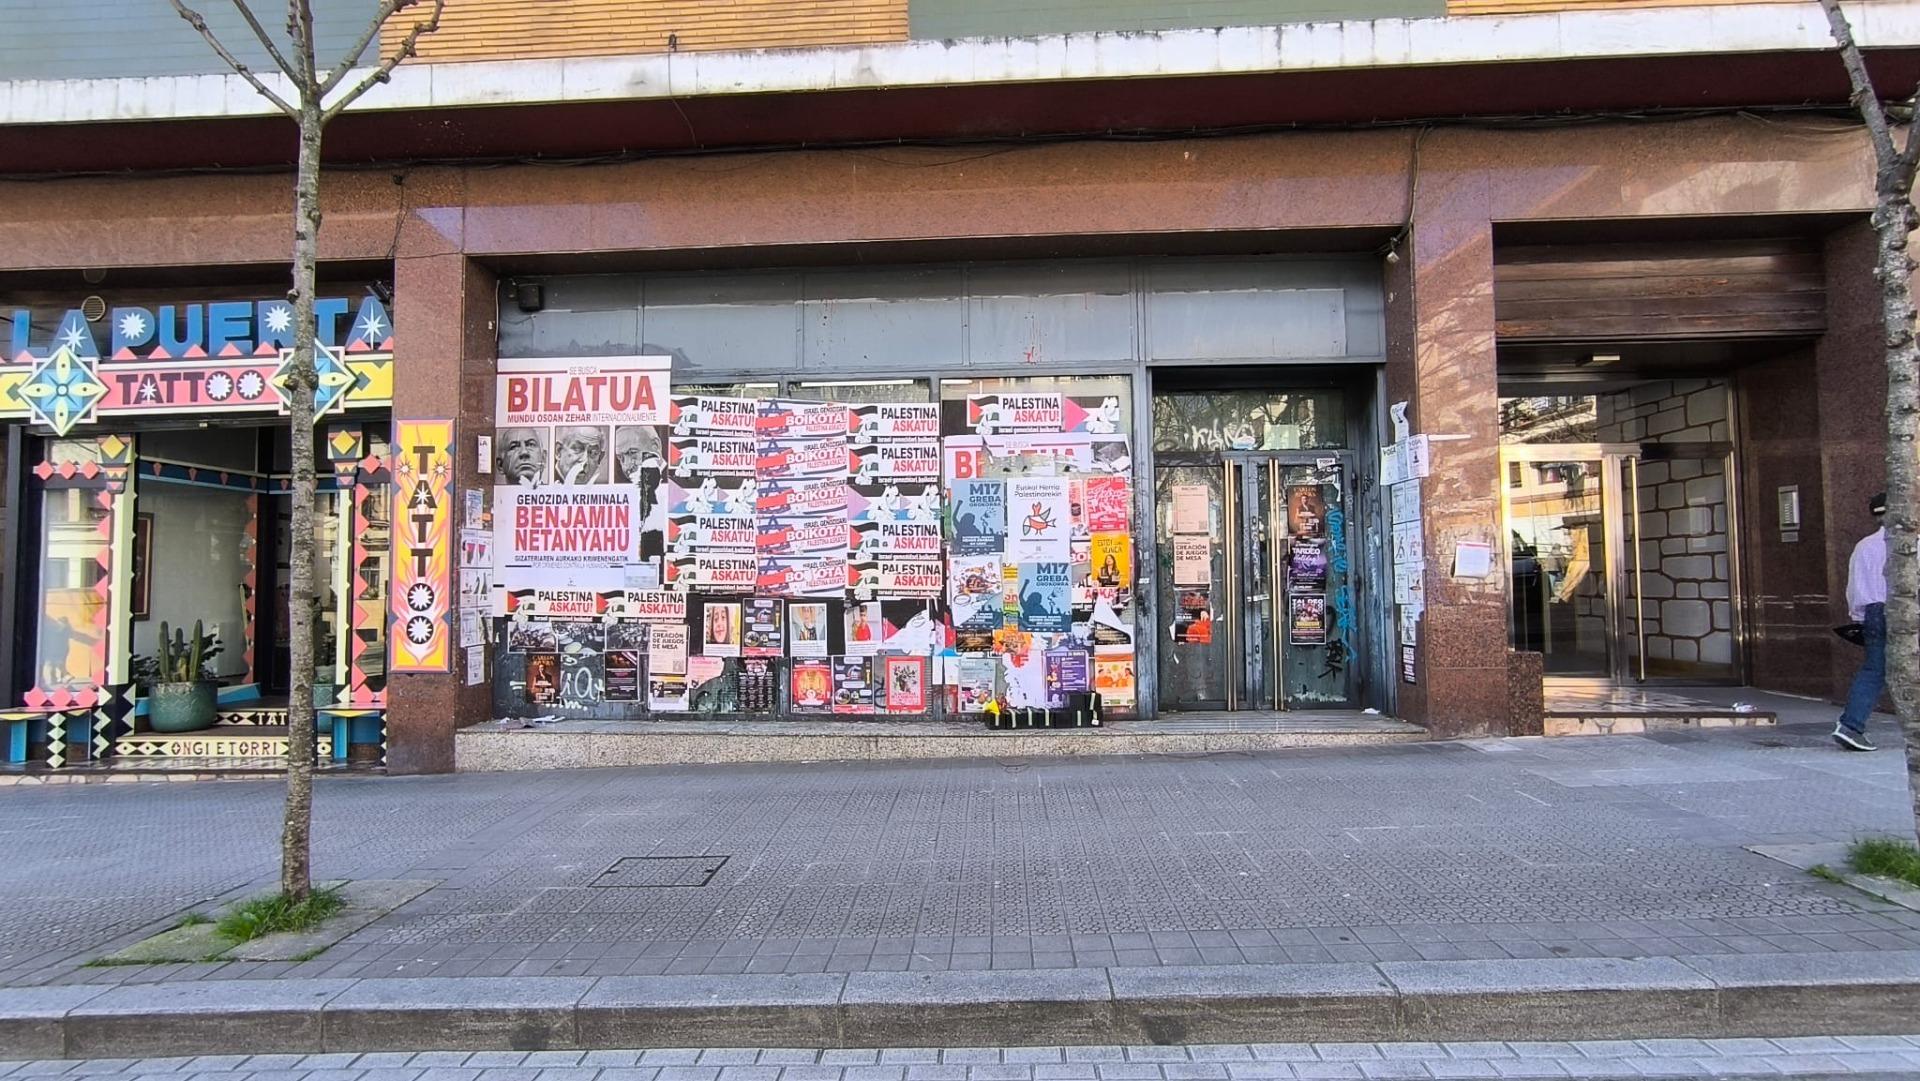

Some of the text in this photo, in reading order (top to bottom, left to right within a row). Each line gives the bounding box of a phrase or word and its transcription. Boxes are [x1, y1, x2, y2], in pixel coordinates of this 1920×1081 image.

[12, 296, 393, 360] LA PUERTA
[115, 370, 266, 406] TATTOO
[507, 376, 656, 413] BILATUA
[701, 400, 755, 414] PALESTINA
[1002, 397, 1060, 410] PALESTINA
[507, 414, 535, 423] MUNDU
[537, 414, 564, 423] OSOAN
[565, 413, 592, 422] ZEHAR
[785, 412, 847, 426] BOIKOTA!
[881, 407, 938, 420] PALESTINA
[1013, 410, 1060, 422] ASKATU!
[711, 414, 755, 427] ASKATU!
[892, 420, 937, 432] ASKATU!
[701, 441, 756, 454] PALESTINA
[881, 447, 938, 459] PALESTINA
[711, 454, 756, 466] ASKATU!
[785, 445, 847, 464] BOIKOTA!
[893, 459, 938, 472] ASKATU!
[786, 486, 848, 504] BOIKOTA!
[969, 483, 1001, 496] M17
[517, 494, 629, 505] GENOZIDA KRIMINALA
[515, 506, 630, 528] BENJAMIN
[700, 518, 755, 530] PALESTINA
[882, 524, 938, 537] PALESTINA
[711, 531, 755, 543] ASKATU!
[786, 525, 847, 542] BOIKOTA!
[405, 445, 436, 645] TATTOO
[515, 529, 630, 552] NETANYAHU
[893, 537, 938, 549] ASKATU!
[700, 559, 756, 570] PALESTINA
[881, 564, 941, 576] PALESTINA
[1036, 562, 1069, 574] M17
[711, 571, 755, 581] ASKATU!
[893, 576, 941, 587] ASKATU!
[538, 590, 594, 602] PALESTINA
[627, 591, 684, 604] PALESTINA
[549, 602, 593, 613] ASKATU!
[639, 603, 684, 615] ASKATU!
[171, 741, 277, 756] ONGI ETORRI
